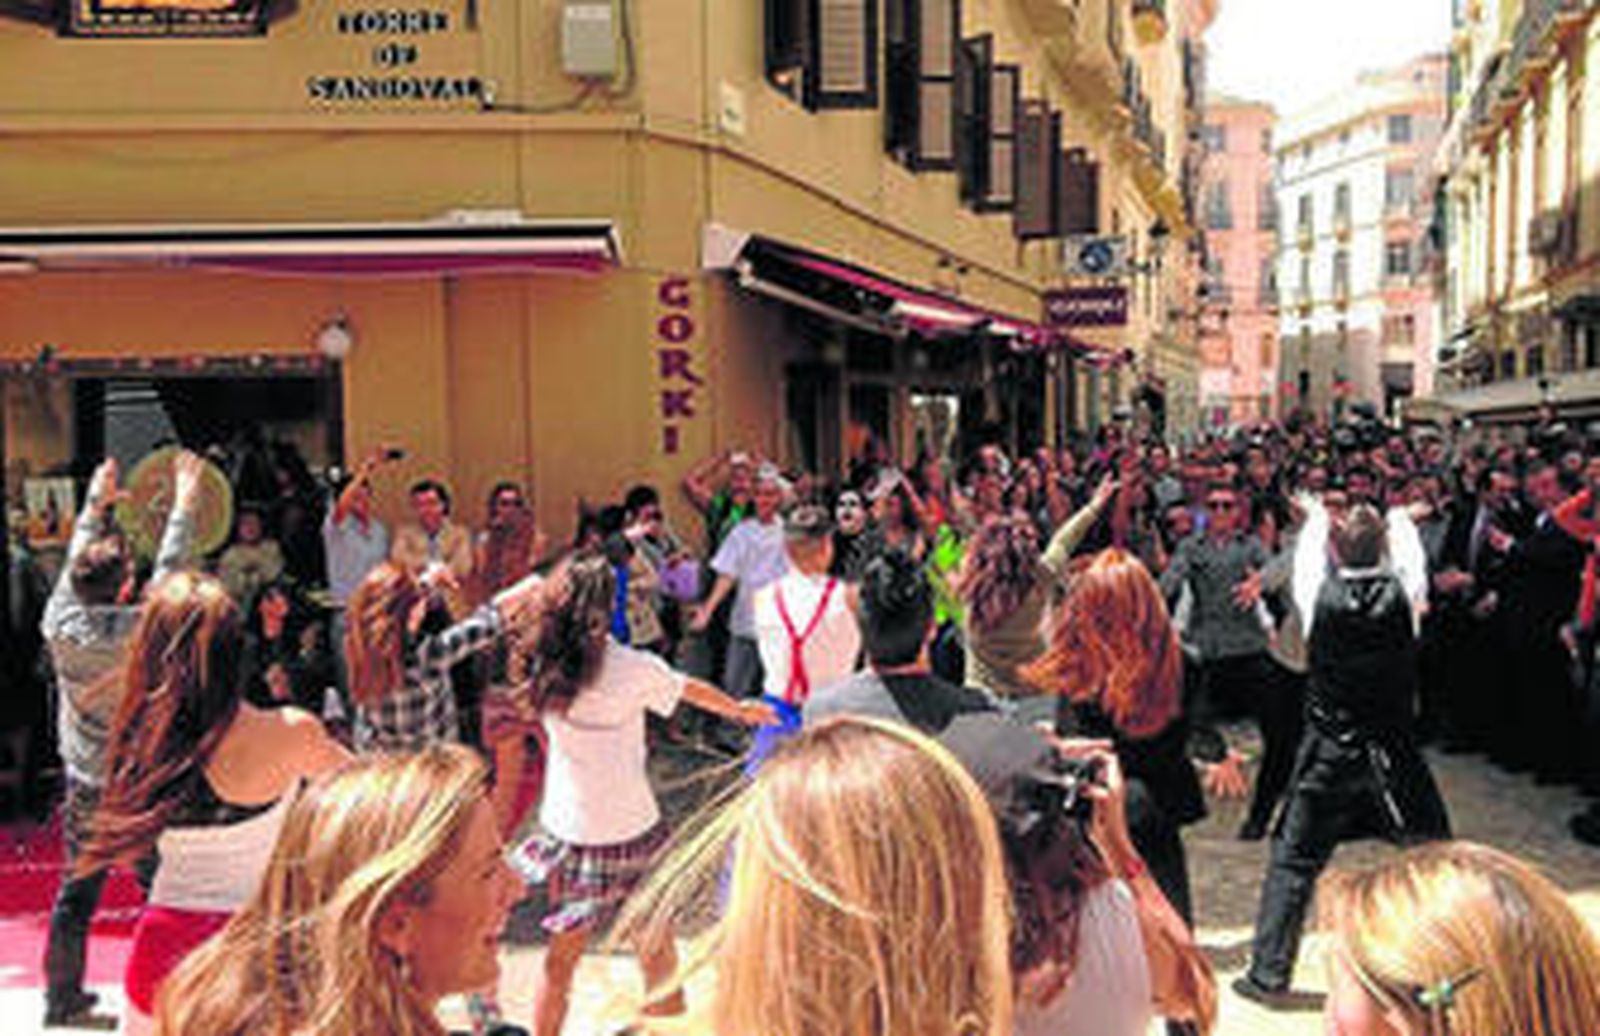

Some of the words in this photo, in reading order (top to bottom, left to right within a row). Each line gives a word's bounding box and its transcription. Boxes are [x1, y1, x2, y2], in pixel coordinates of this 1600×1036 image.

[337, 10, 449, 34] TORRE
[373, 42, 419, 67] DE
[307, 76, 485, 100] SANDOVAL
[658, 276, 703, 454] GORKI
